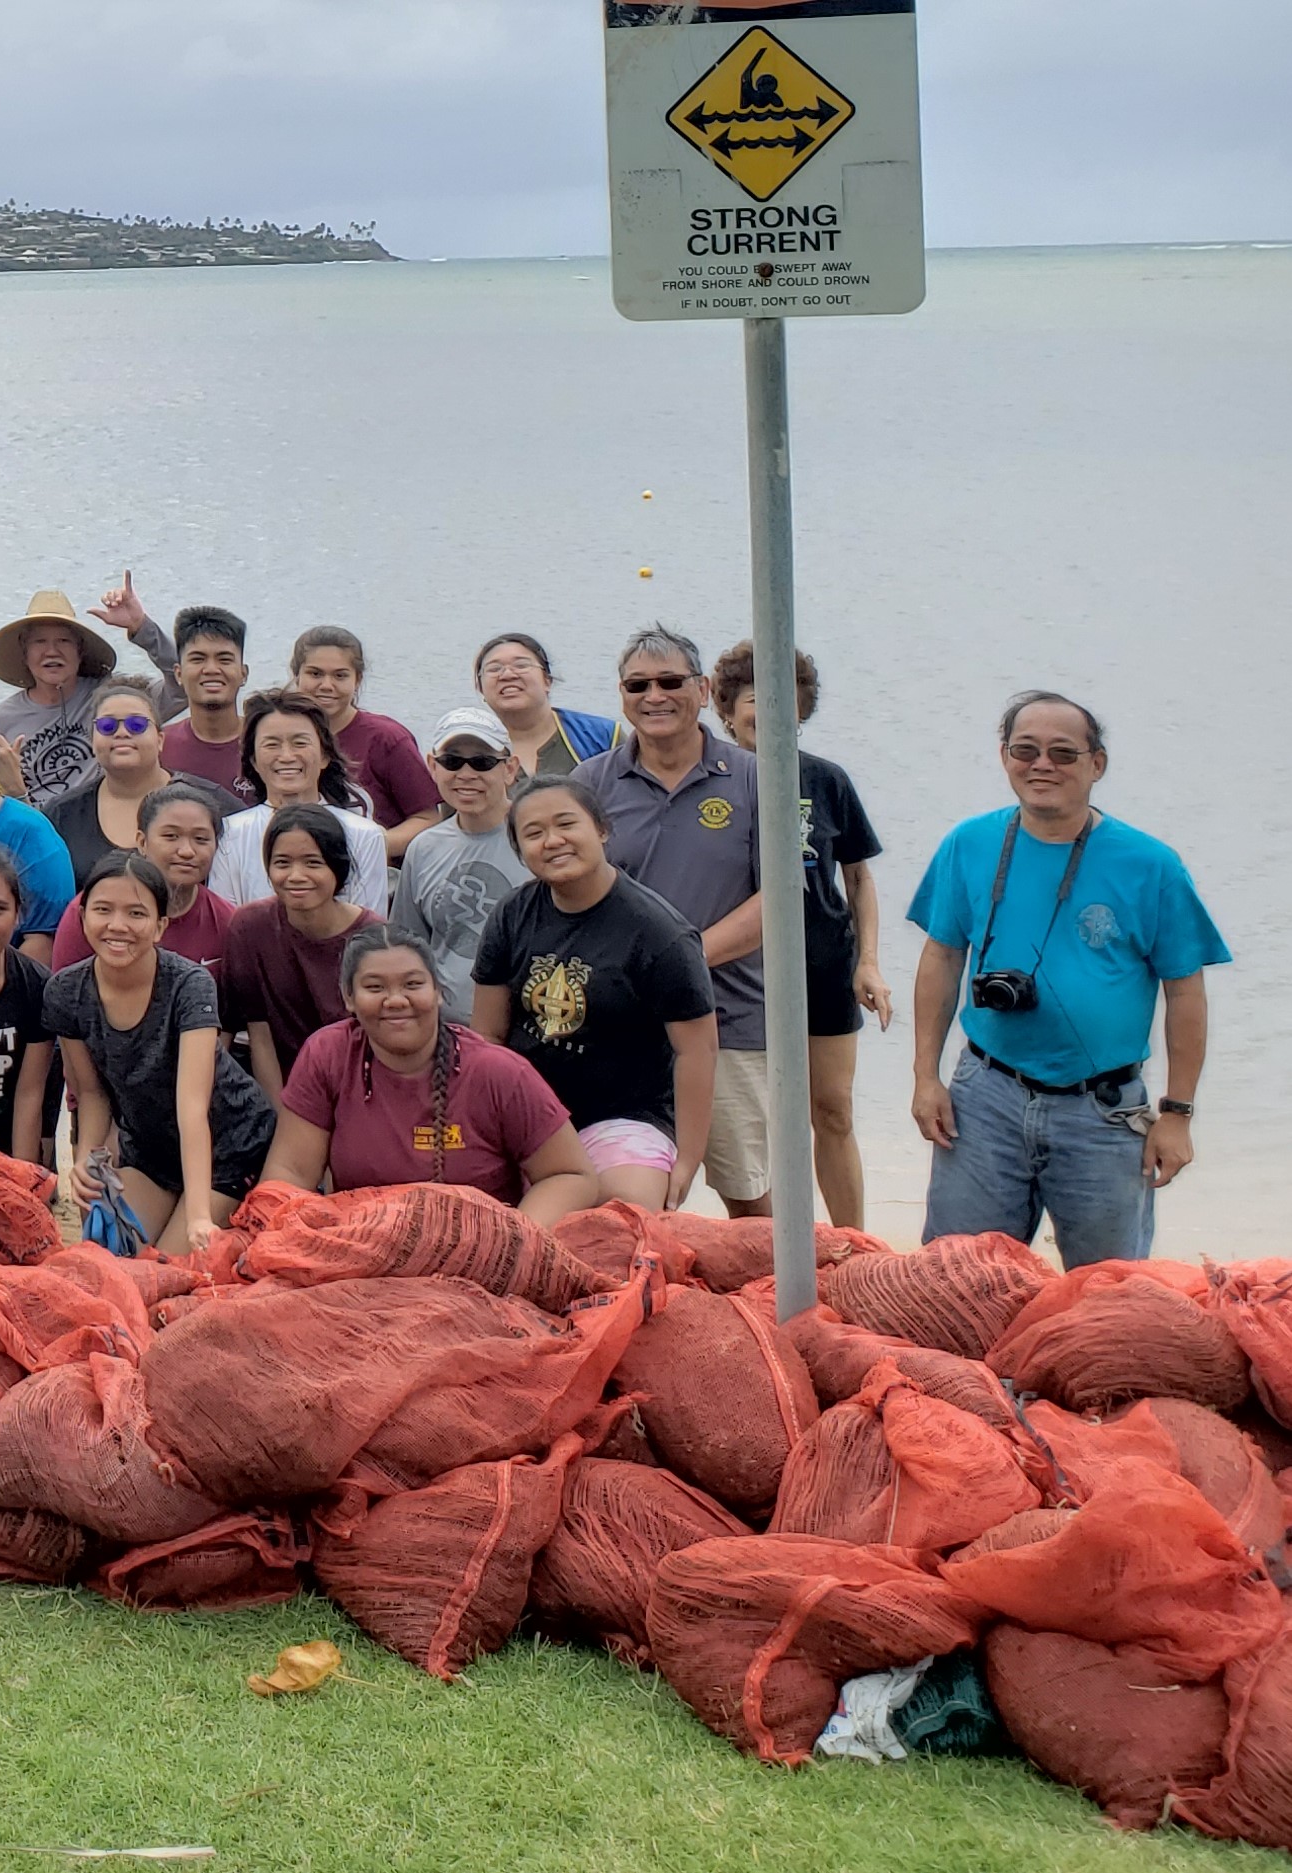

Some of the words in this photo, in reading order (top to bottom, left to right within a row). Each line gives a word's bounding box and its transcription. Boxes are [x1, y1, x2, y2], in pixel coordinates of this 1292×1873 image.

[690, 204, 838, 231] STRONG
[687, 230, 842, 256] CURRENT
[678, 266, 703, 276] YOU
[708, 265, 748, 275] COULD
[774, 263, 816, 273] SWEPT
[821, 262, 852, 272] AWAY
[662, 280, 696, 291] FROM
[701, 279, 743, 289] SHORE
[748, 278, 772, 288] AND
[777, 277, 819, 287] COULD
[824, 275, 870, 285] DROWN
[681, 300, 691, 309] IF
[696, 299, 707, 308] IN
[761, 296, 797, 306] DON'T
[802, 295, 821, 305] GO
[826, 295, 852, 304] OUT
